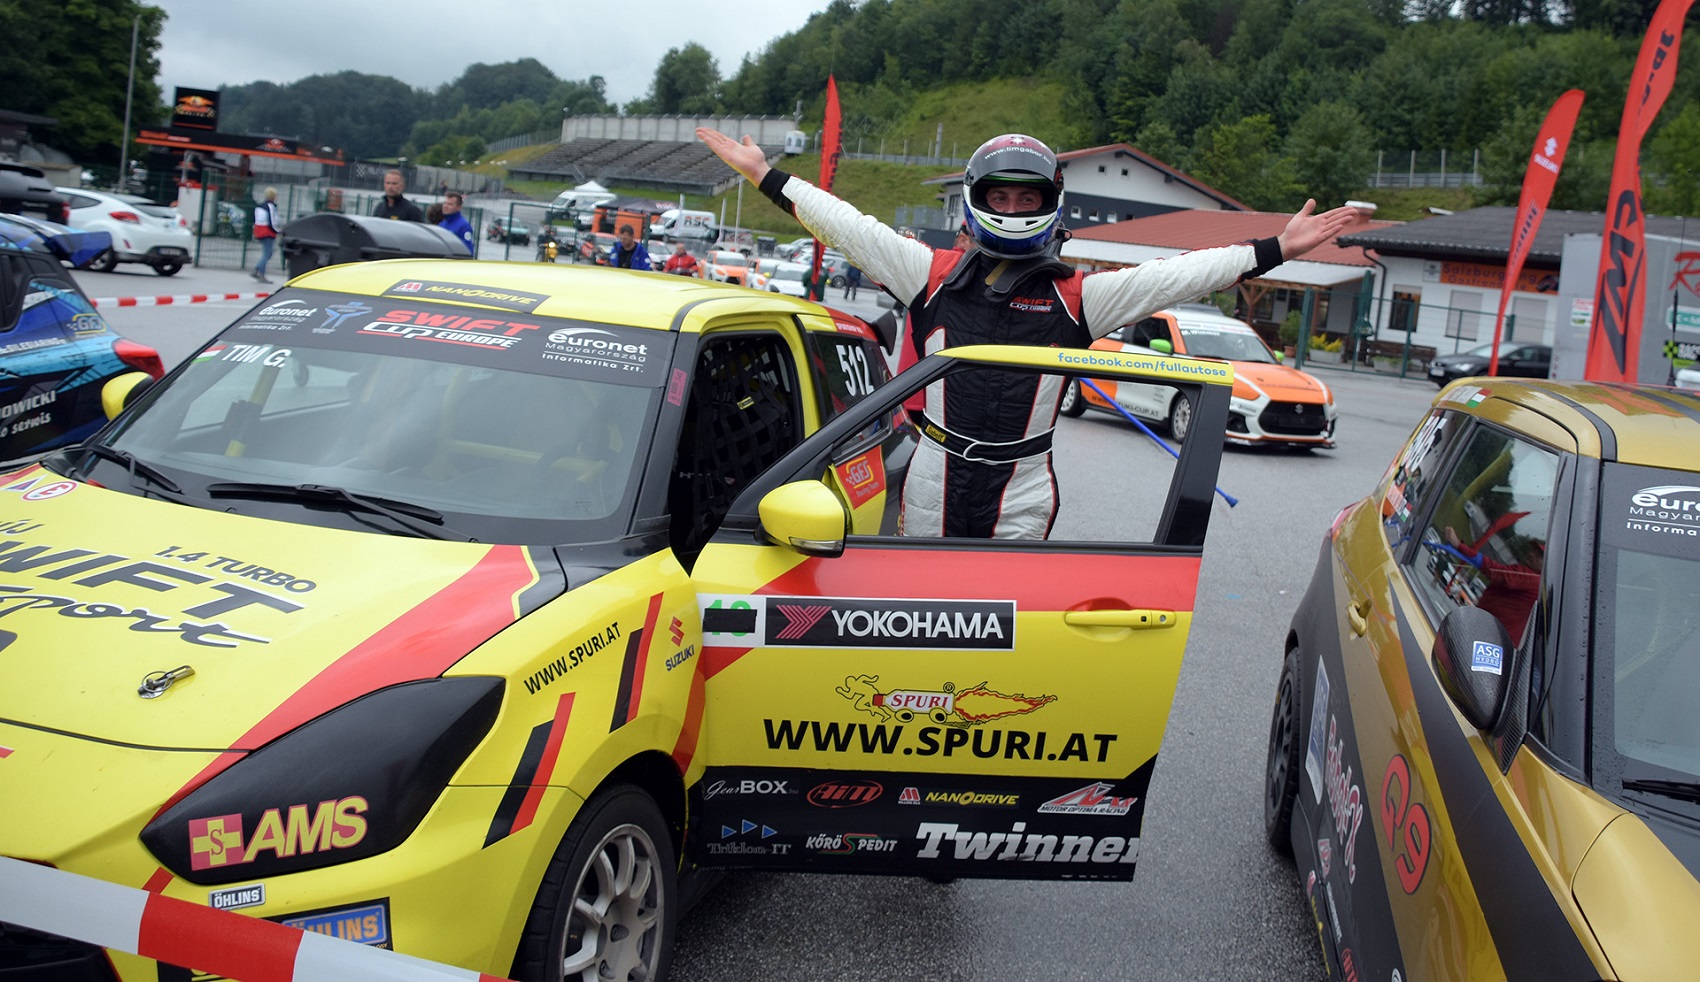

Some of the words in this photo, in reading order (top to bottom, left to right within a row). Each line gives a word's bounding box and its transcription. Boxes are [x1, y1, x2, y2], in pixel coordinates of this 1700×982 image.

[1443, 262, 1537, 283] Salzburgng
[424, 285, 538, 305] NANODRIVE
[1012, 296, 1055, 306] SWIFT
[258, 306, 318, 317] euronet
[376, 310, 541, 337] SWIFT
[363, 321, 434, 339] CUP
[433, 331, 521, 348] EUROPE
[547, 332, 648, 356] euronet
[221, 344, 271, 363] TIM
[263, 348, 292, 368] G.
[541, 352, 618, 369] Informatika
[622, 363, 644, 374] Zrt.
[544, 342, 647, 363] Magyarország
[1056, 352, 1227, 377] facebook.com/fullautose
[835, 344, 875, 397] 512
[0, 540, 306, 620] WIFT
[154, 545, 206, 564] 1.4
[204, 555, 318, 594] TURBO
[831, 609, 1005, 640] YOKOHAMA
[523, 621, 622, 696] WWW.SPURI.AT
[664, 645, 695, 672] SUZUKI
[1476, 644, 1500, 659] ASG
[890, 692, 950, 710] SPURI
[763, 718, 1118, 764] WWW.SPURI.AT
[925, 791, 1020, 805] NANODRIVE
[209, 828, 225, 857] S
[242, 795, 369, 863] AMS
[213, 886, 262, 910] ÖHLINS
